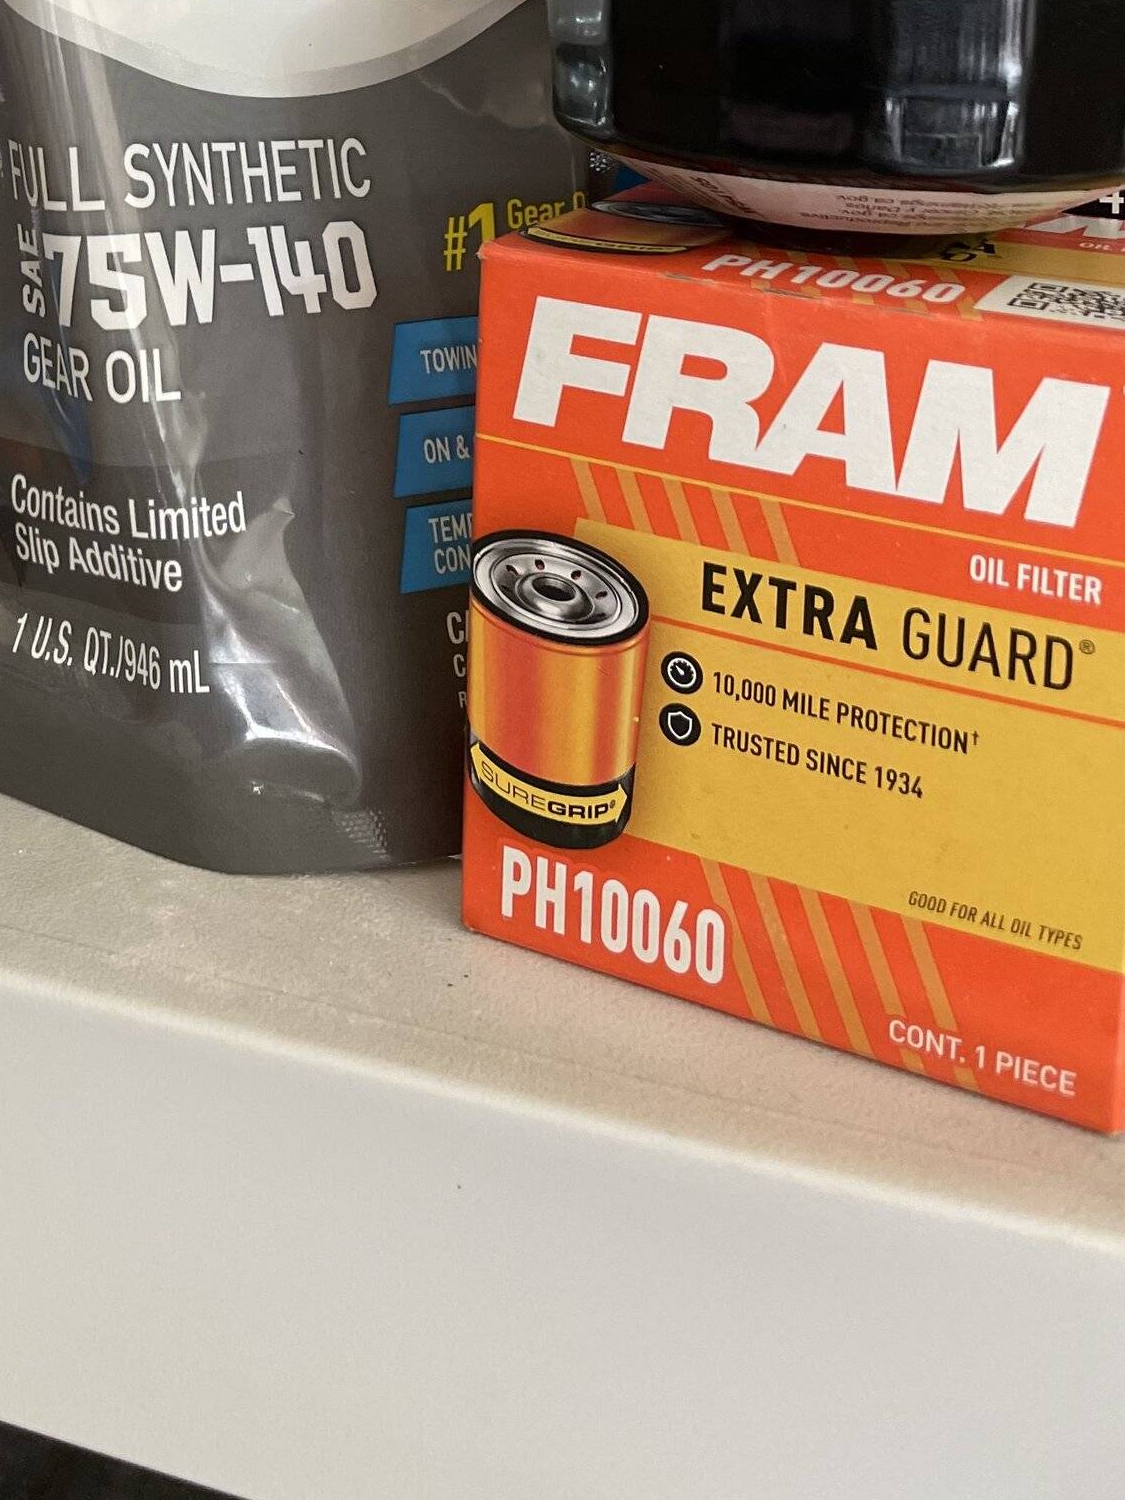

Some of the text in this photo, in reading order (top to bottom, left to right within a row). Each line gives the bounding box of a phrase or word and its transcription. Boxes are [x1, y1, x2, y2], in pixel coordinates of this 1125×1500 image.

[8, 137, 371, 211] FULL SYNTHETIC
[17, 223, 47, 318] SAE
[42, 221, 377, 331] 75W-140
[701, 254, 966, 304] PH10060
[23, 332, 181, 403] GEAR OIL
[420, 343, 478, 374] TOWIN
[512, 295, 1111, 529] FRAM
[423, 436, 470, 465] ON &
[11, 474, 246, 541] Contains Limited
[15, 523, 183, 592] Slip Additive
[969, 553, 1104, 606] OIL FILTER
[701, 560, 879, 651] EXTRA
[12, 613, 28, 653] 1
[31, 616, 72, 666] U.S.
[169, 650, 210, 693] mL
[712, 670, 777, 708] 10,000
[782, 684, 831, 722] MILE
[710, 723, 924, 799] TRUSTED SINCE 1934
[501, 844, 726, 987] PH10060
[907, 890, 1084, 951] GOOD FOR ALL OIL TYPES
[888, 1018, 1077, 1098] CONT. 1 PIECE
